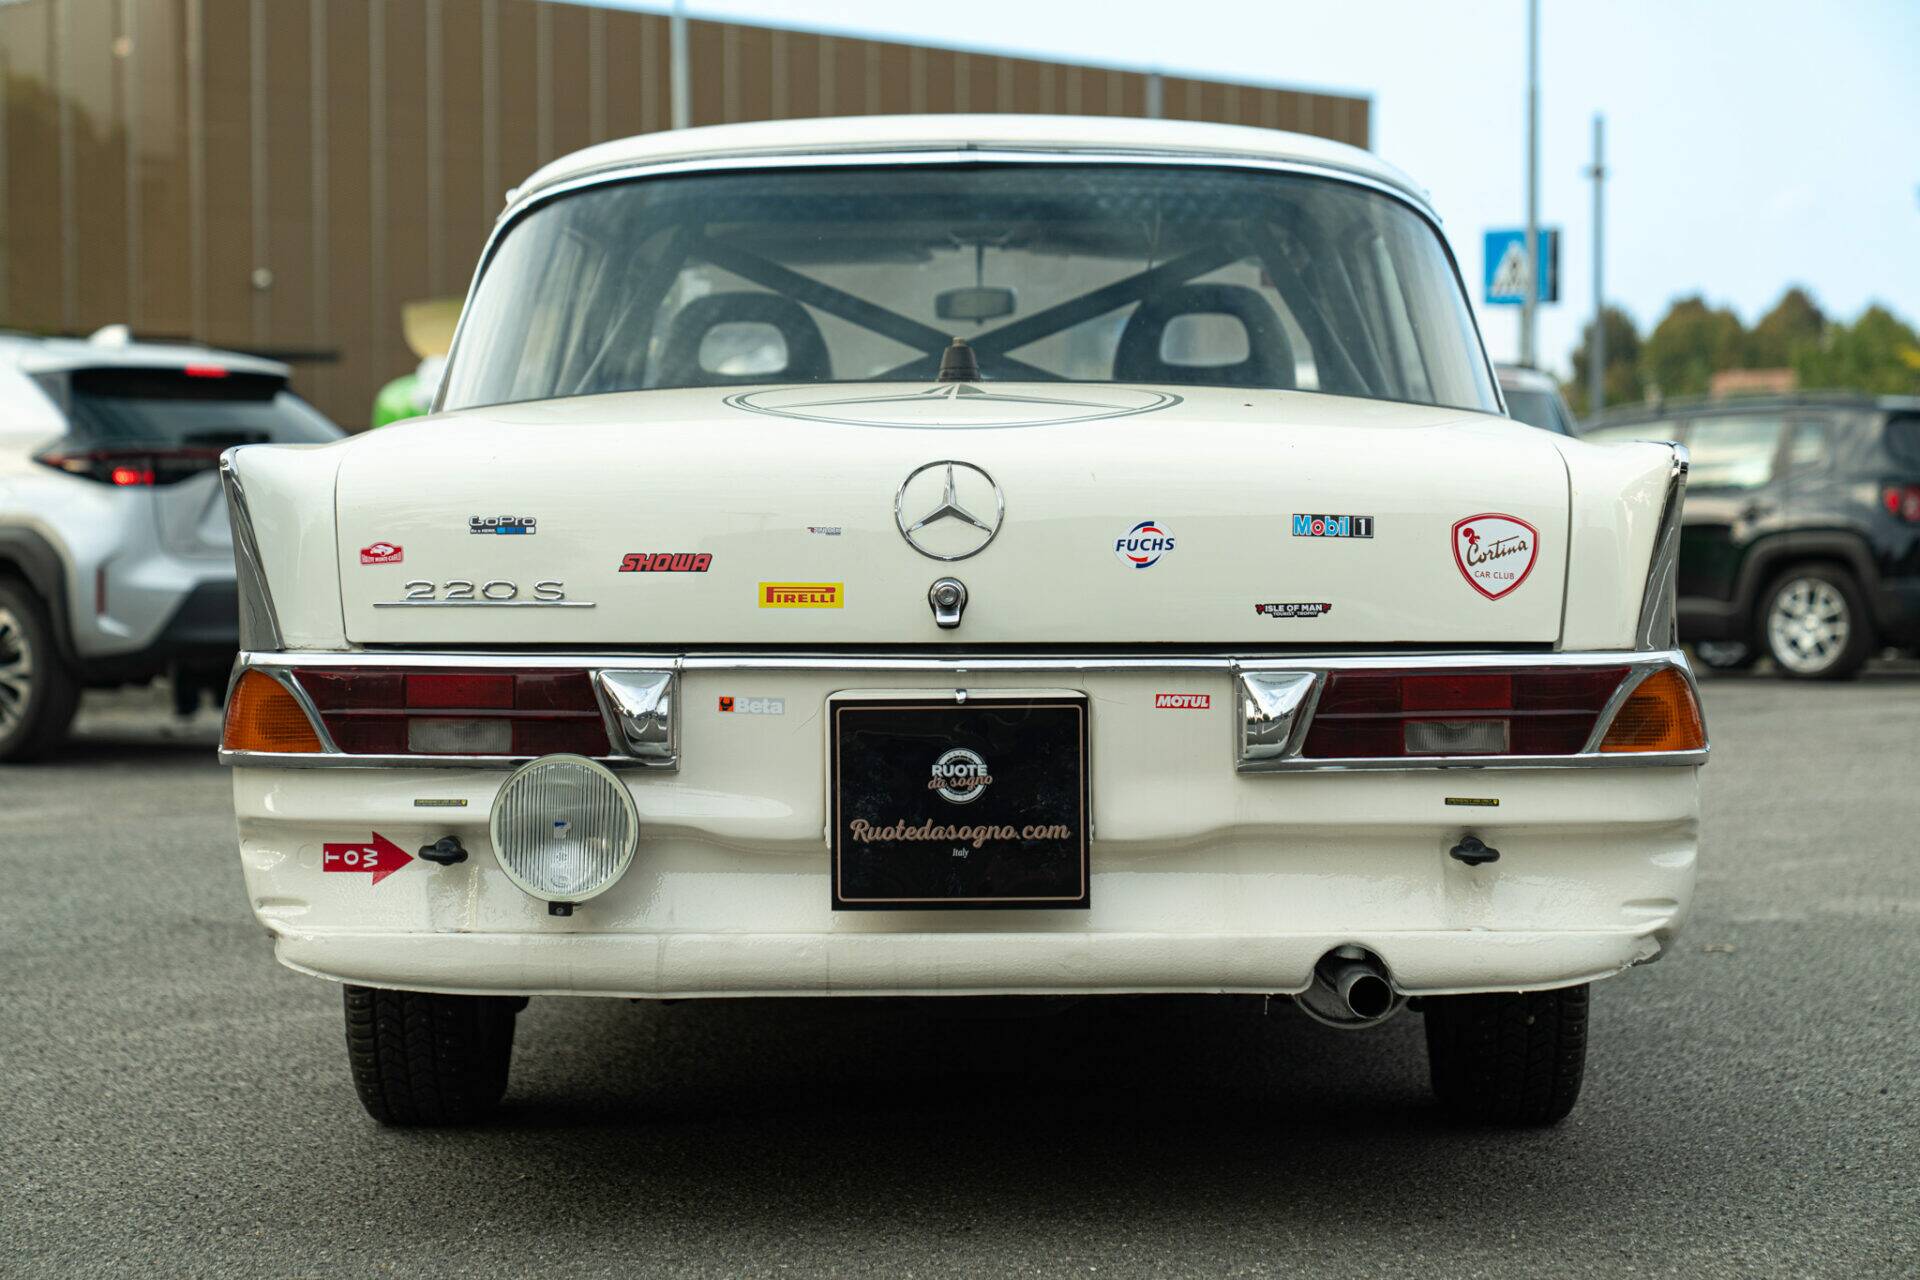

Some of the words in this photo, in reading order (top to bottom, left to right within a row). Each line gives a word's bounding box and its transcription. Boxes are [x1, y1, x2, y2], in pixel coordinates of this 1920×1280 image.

[469, 516, 536, 527] GoPro
[1293, 515, 1351, 537] Mobil
[1357, 518, 1367, 536] 1
[1115, 537, 1175, 552] FUCHS
[1466, 535, 1529, 566] Cortina
[618, 553, 713, 572] SHOWA
[1474, 570, 1491, 579] CAR
[1493, 571, 1515, 580] CLUB
[405, 579, 519, 601] 220
[534, 579, 566, 601] S
[766, 586, 836, 603] PIRELLI
[1286, 604, 1300, 612] OF
[1301, 604, 1323, 612] MAN
[735, 698, 783, 714] Beta
[1156, 695, 1209, 708] MOTUL
[932, 764, 988, 777] RUOTE
[950, 775, 993, 791] sogno
[849, 818, 1071, 848] Ruotedasogno.com
[325, 848, 378, 868] TOW
[952, 847, 970, 859] Italy
